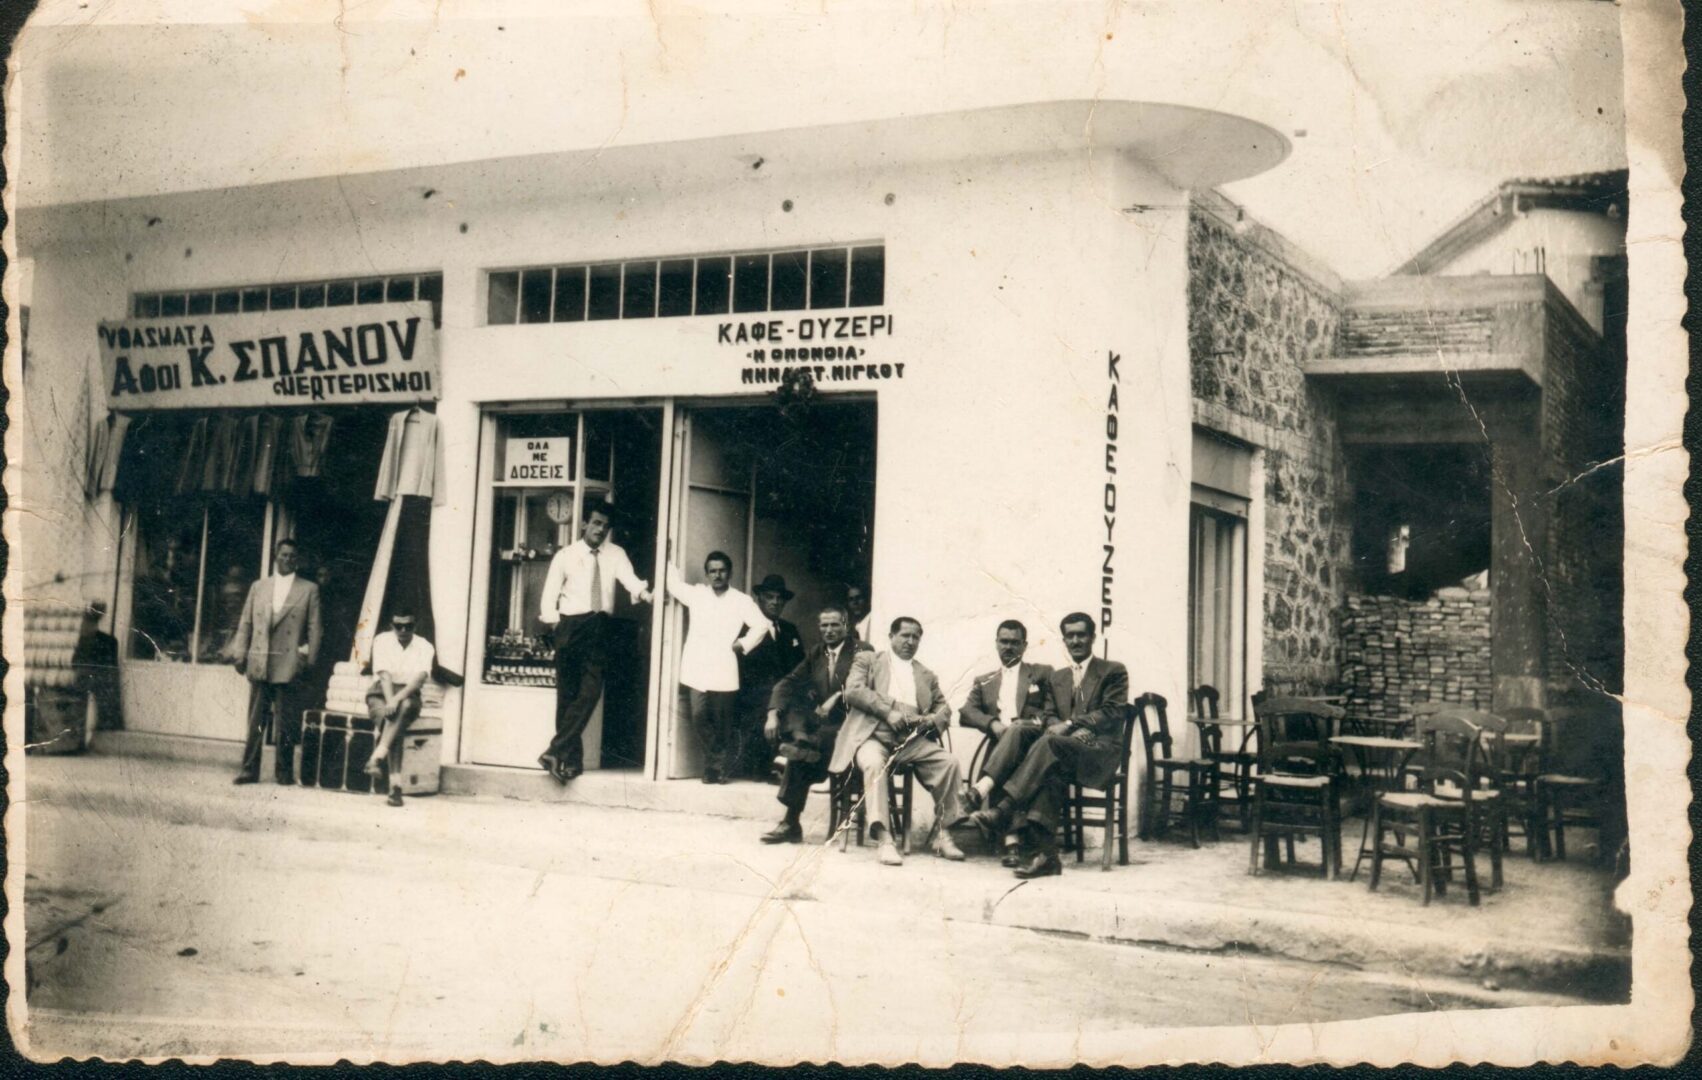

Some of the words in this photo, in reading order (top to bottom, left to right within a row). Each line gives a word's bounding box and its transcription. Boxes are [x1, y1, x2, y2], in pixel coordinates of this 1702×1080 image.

[718, 314, 893, 344] ΚΑΦΕ-ΟΥΖΕΡΙ
[532, 452, 548, 462] ΜΕ
[510, 464, 564, 479] ΔΟΣΕΙΣ
